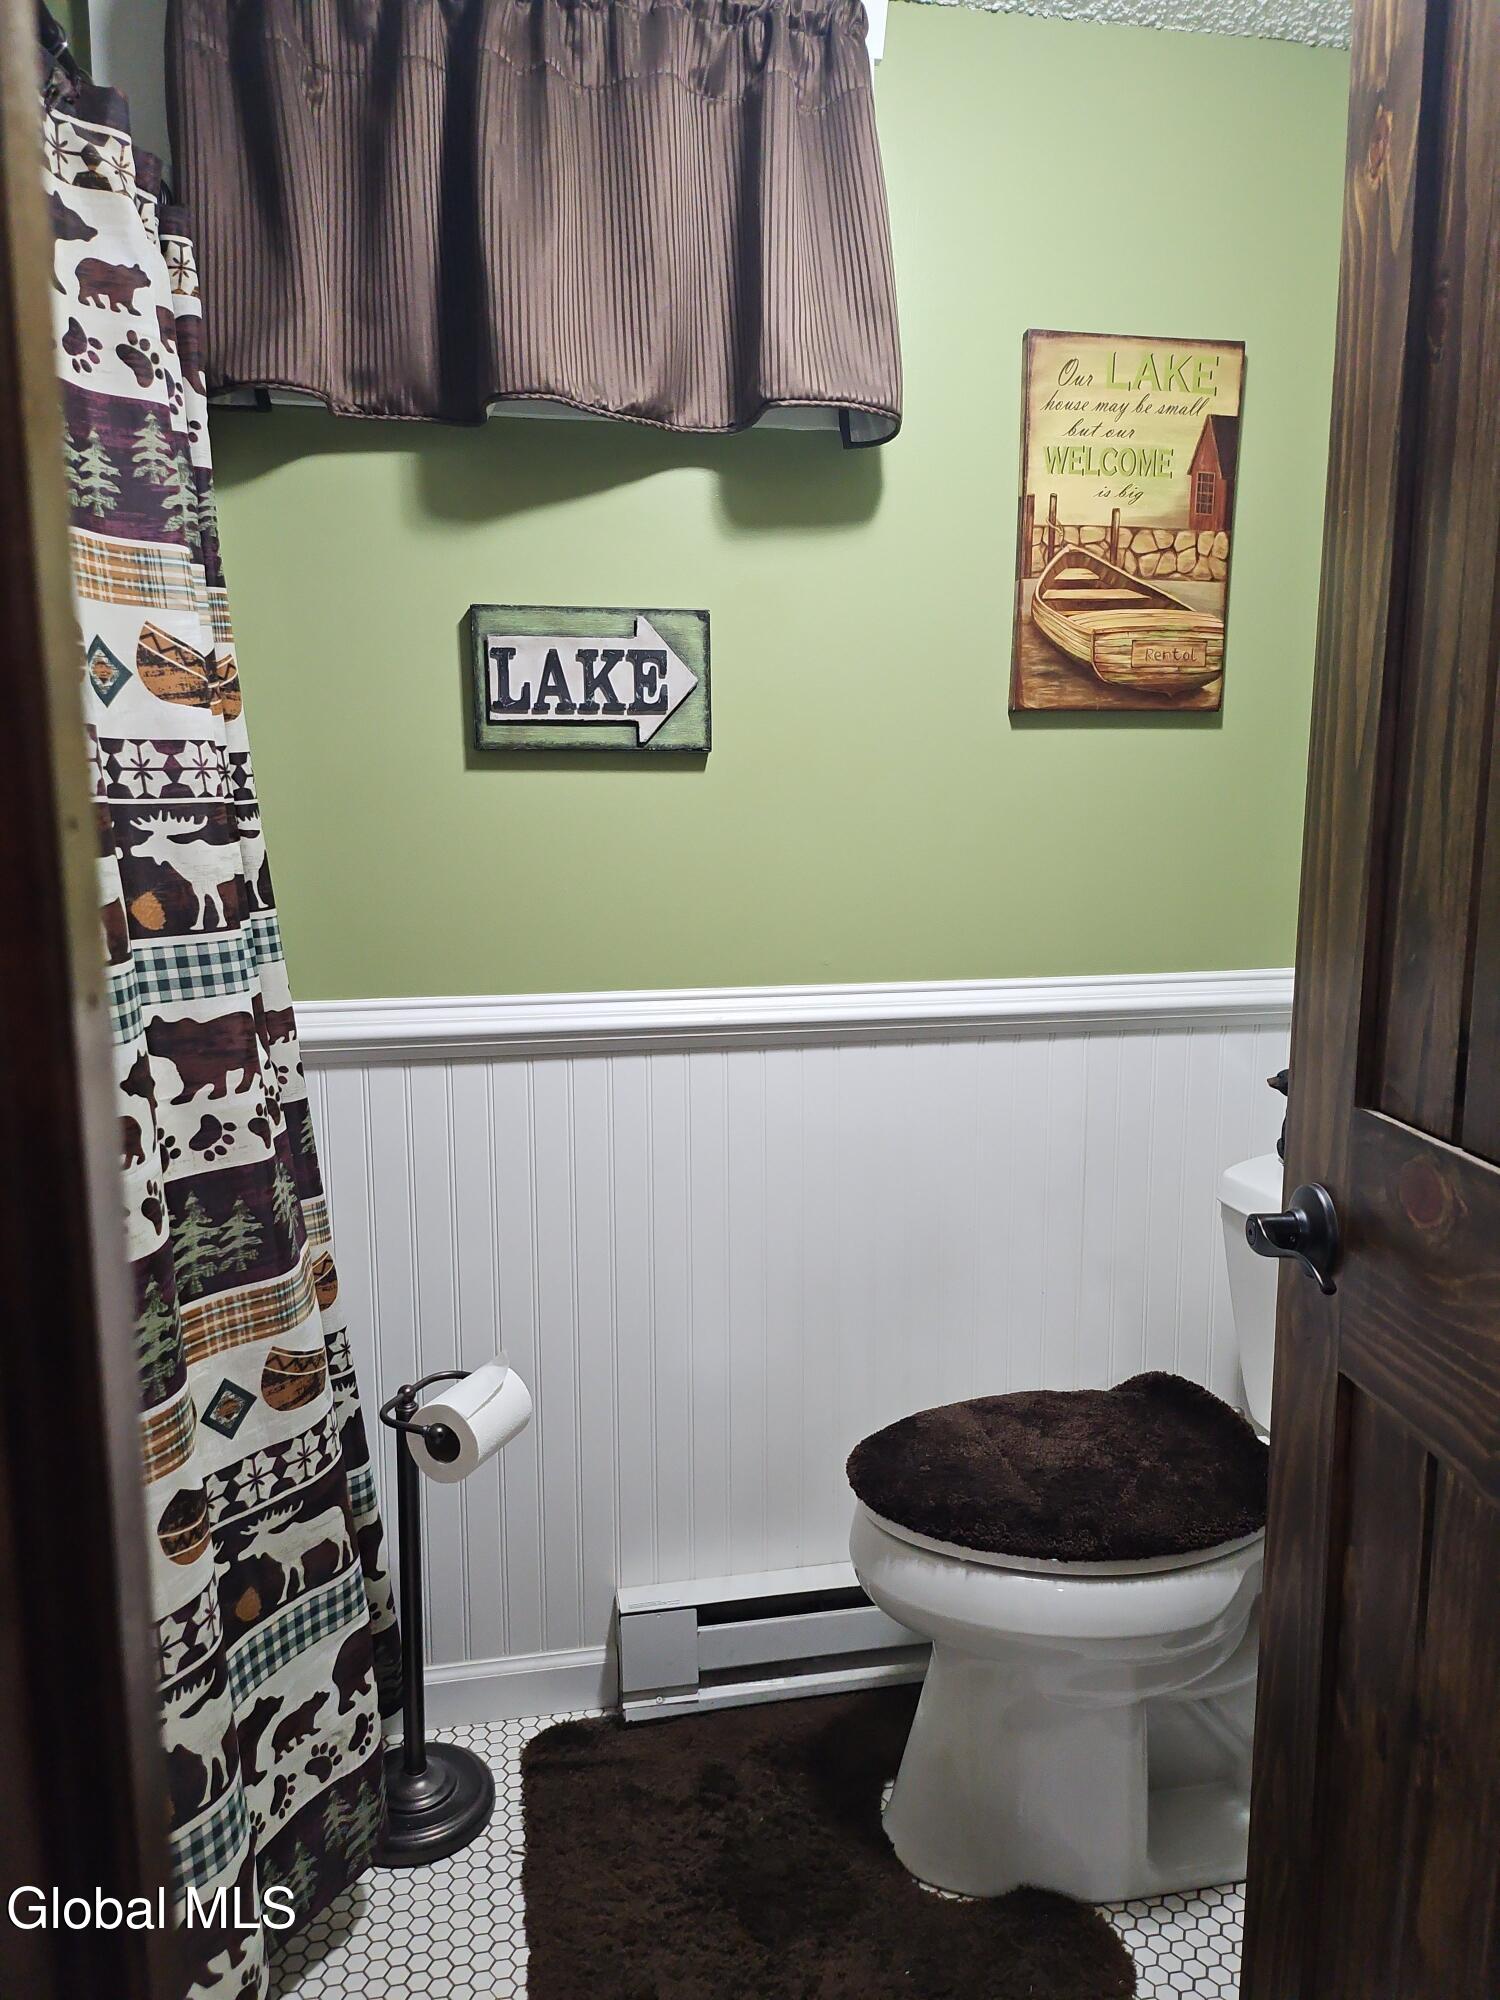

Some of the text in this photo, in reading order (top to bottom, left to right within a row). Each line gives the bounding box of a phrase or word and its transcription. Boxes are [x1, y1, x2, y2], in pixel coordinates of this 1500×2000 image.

[1057, 351, 1220, 396] Our LAKE
[1041, 390, 1210, 422] house may be small
[1062, 418, 1135, 438] but our
[1044, 445, 1174, 479] WELCOME
[1092, 483, 1144, 505] is big
[490, 647, 669, 715] LAKE
